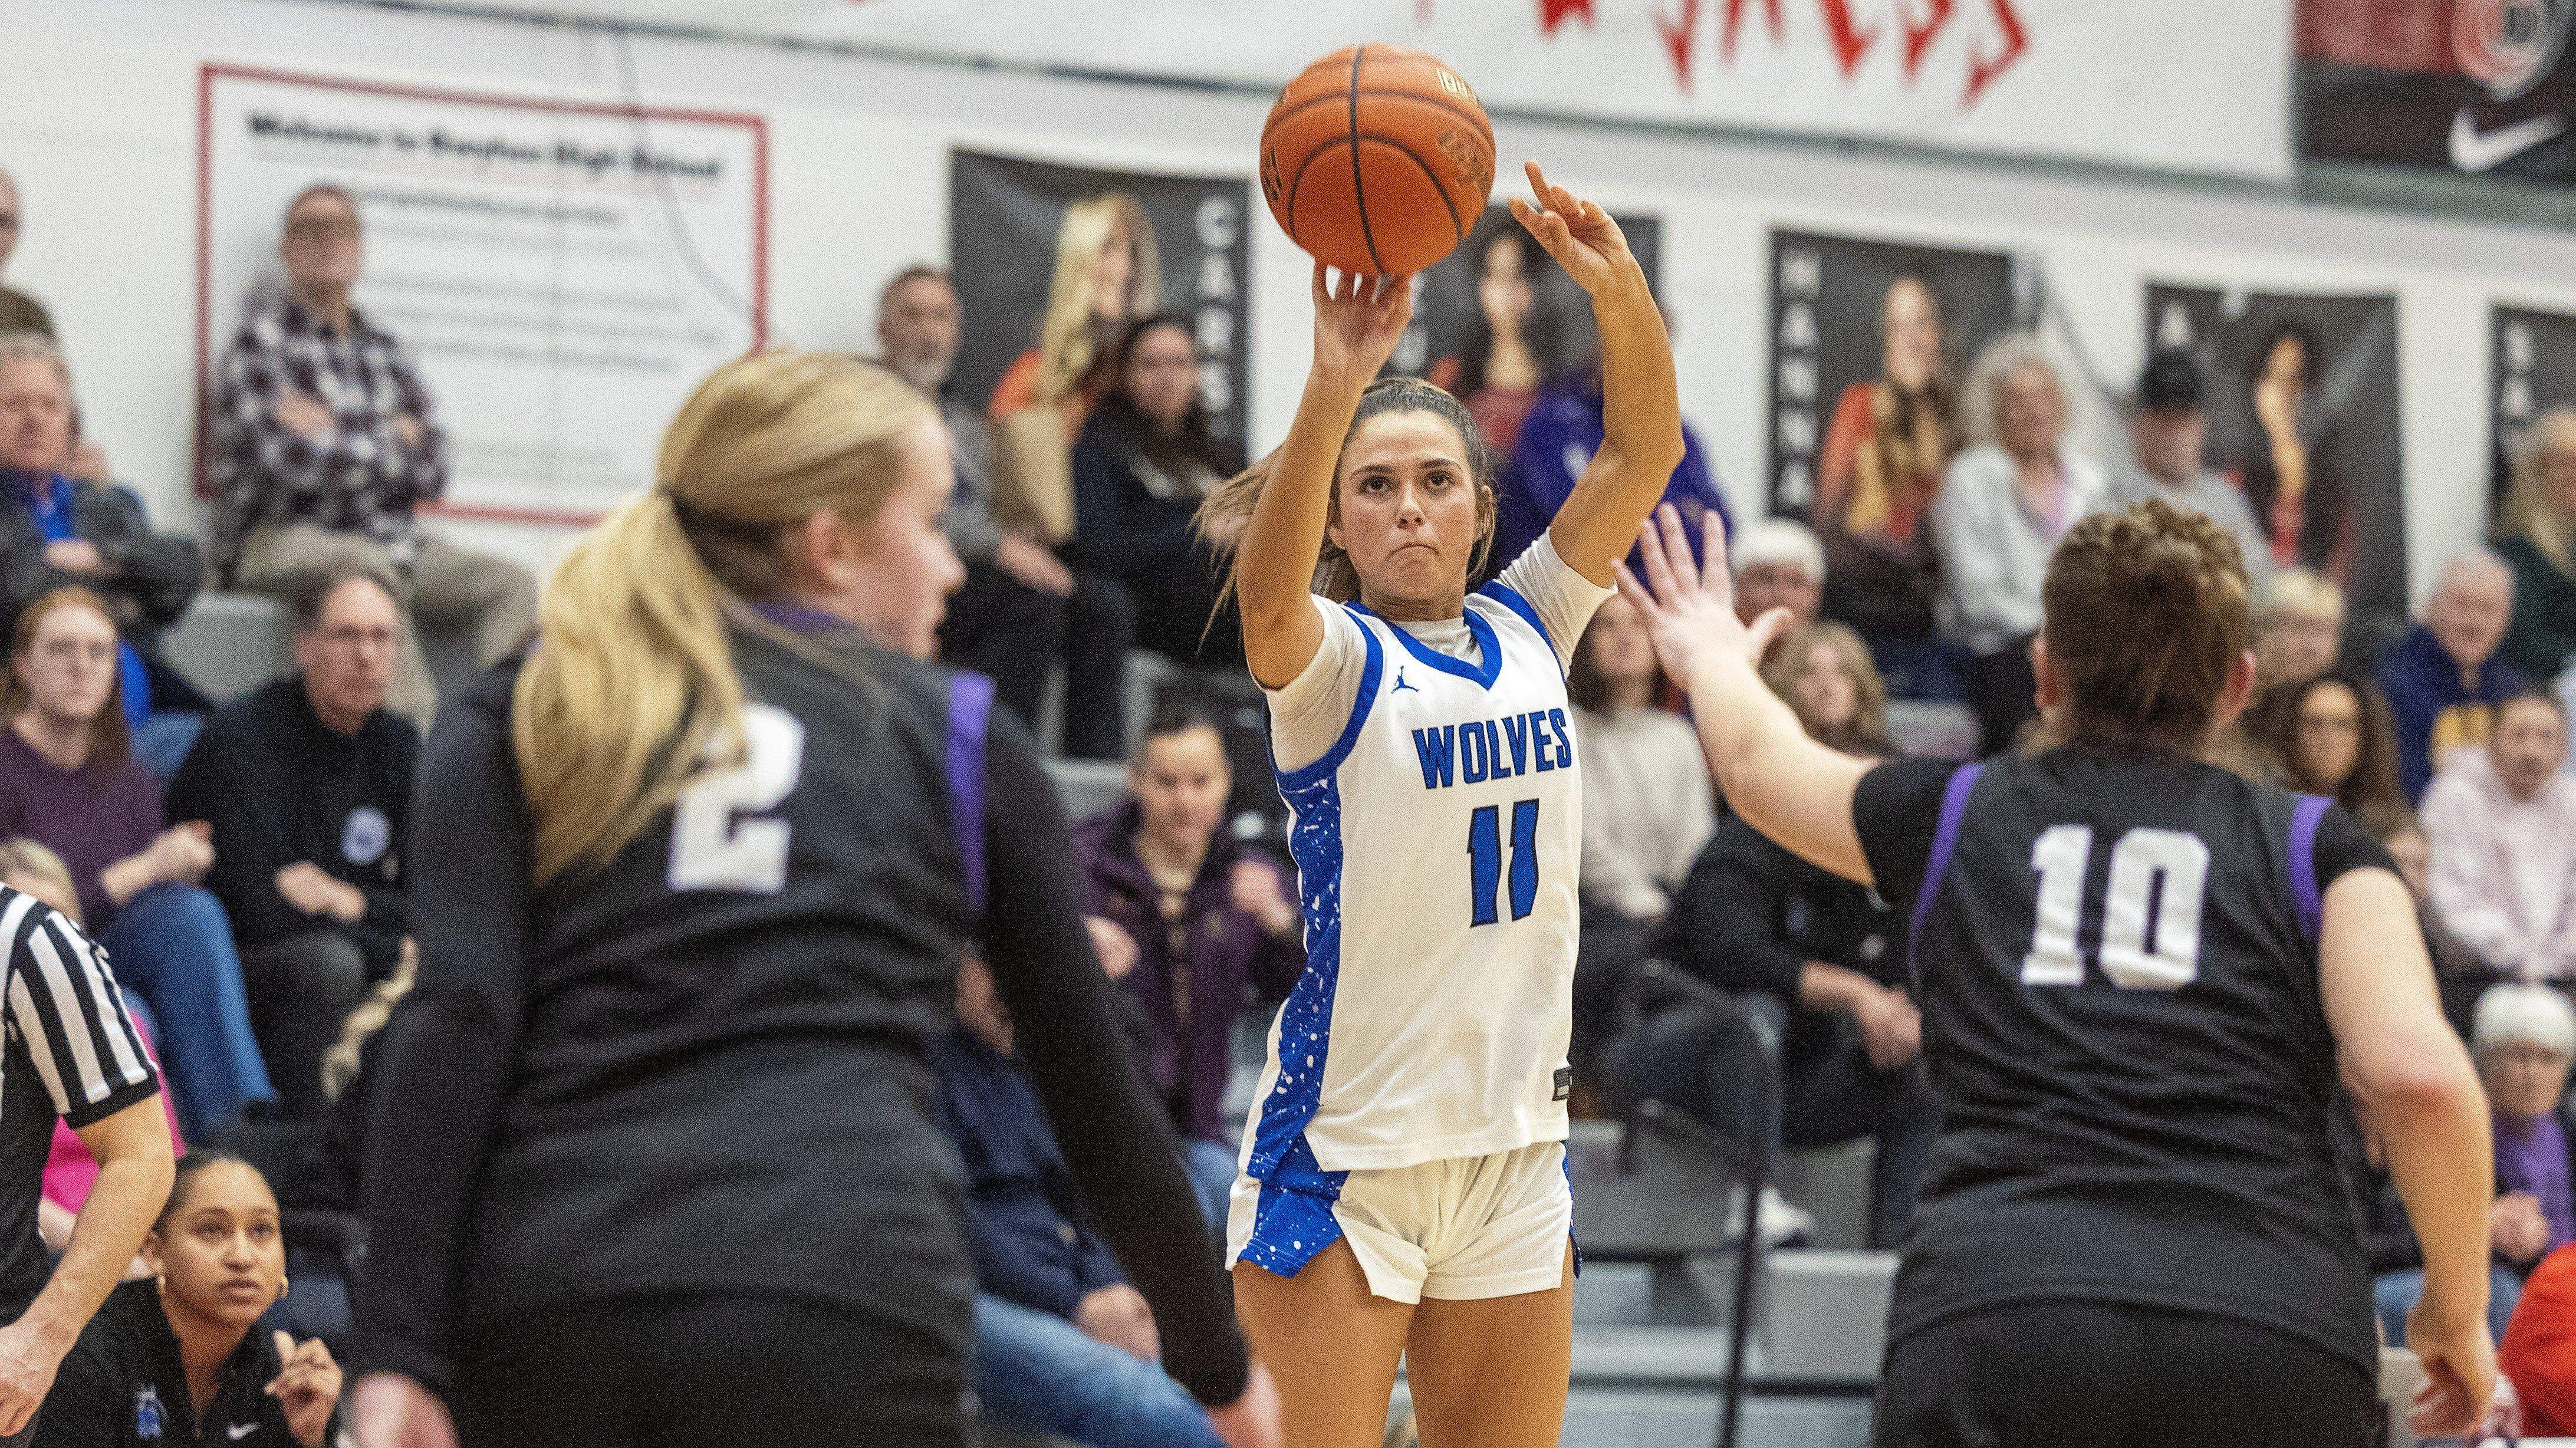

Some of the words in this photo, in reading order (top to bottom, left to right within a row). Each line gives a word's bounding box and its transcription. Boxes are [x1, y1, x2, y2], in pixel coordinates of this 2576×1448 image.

[667, 703, 805, 895] 2
[1411, 707, 1572, 789] WOLVES
[1467, 798, 1540, 929] 11
[2020, 824, 2210, 990] 10
